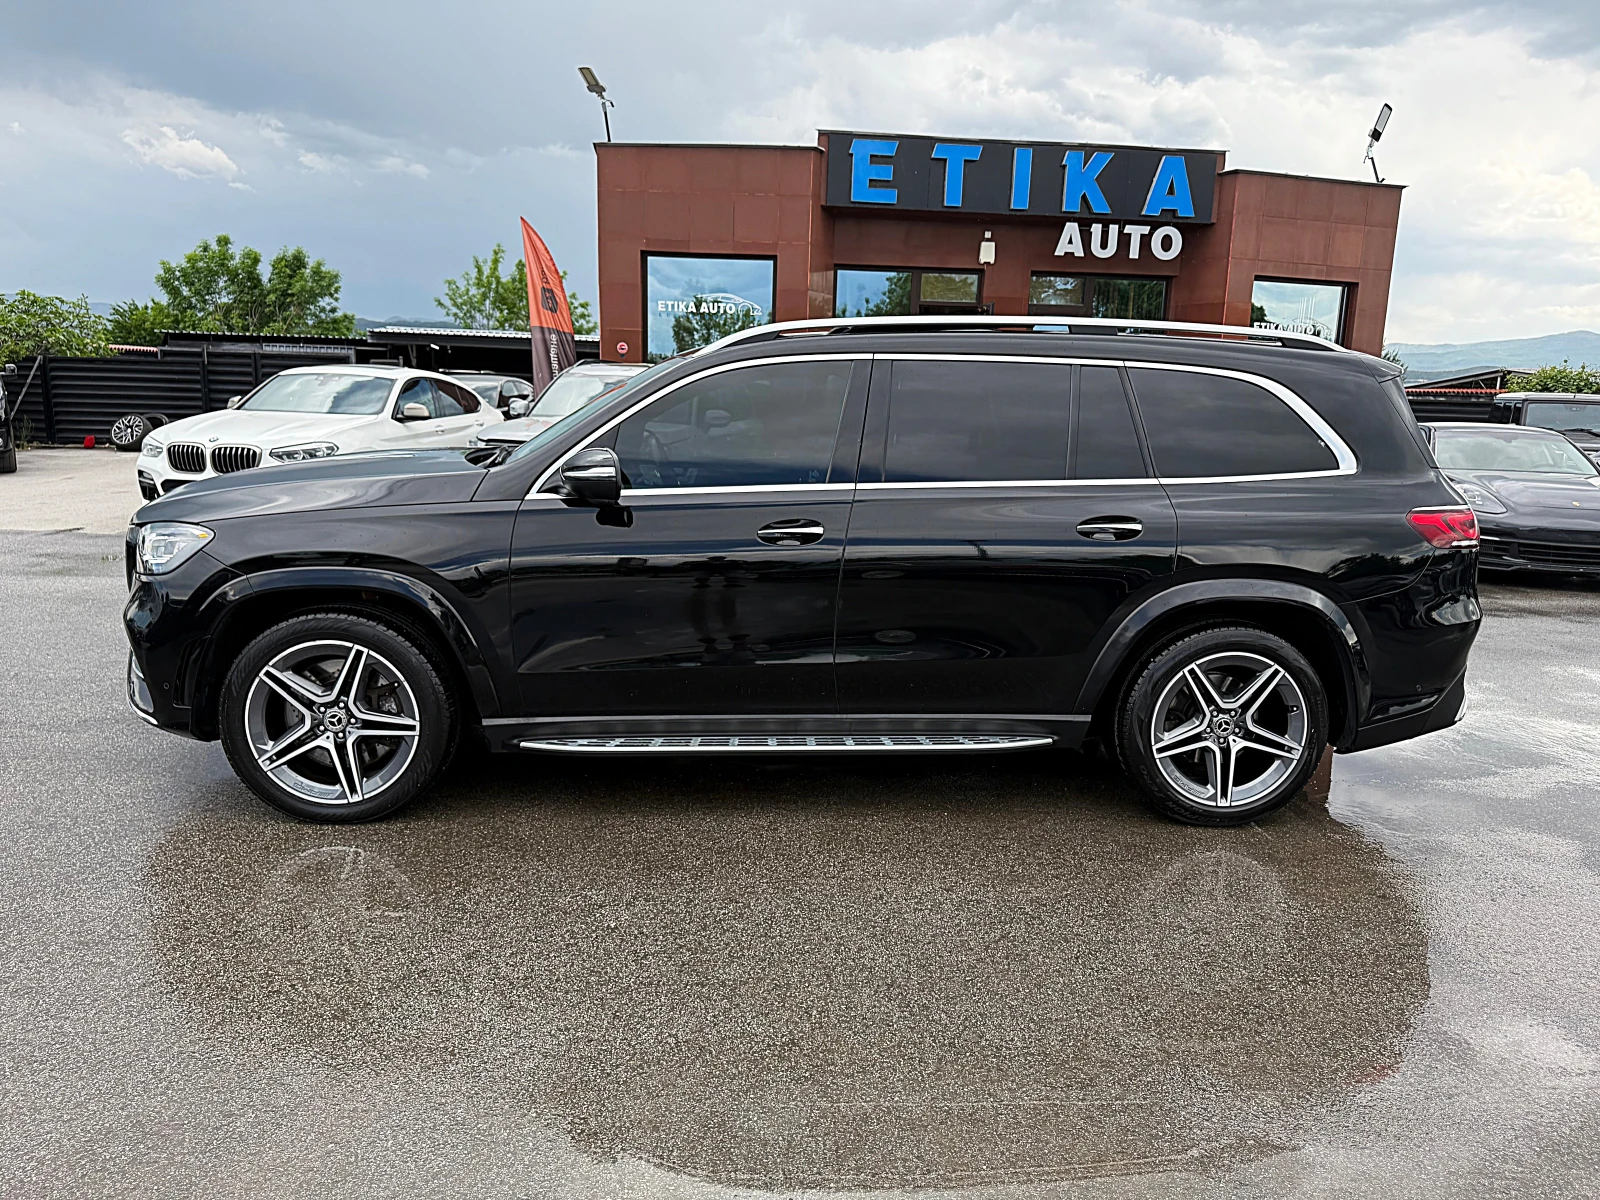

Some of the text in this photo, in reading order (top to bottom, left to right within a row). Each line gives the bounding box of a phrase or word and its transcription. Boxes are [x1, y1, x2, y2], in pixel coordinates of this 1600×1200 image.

[849, 138, 1195, 217] ETIKA
[1054, 222, 1183, 261] AUTO
[657, 301, 736, 314] ETIKA AUTO
